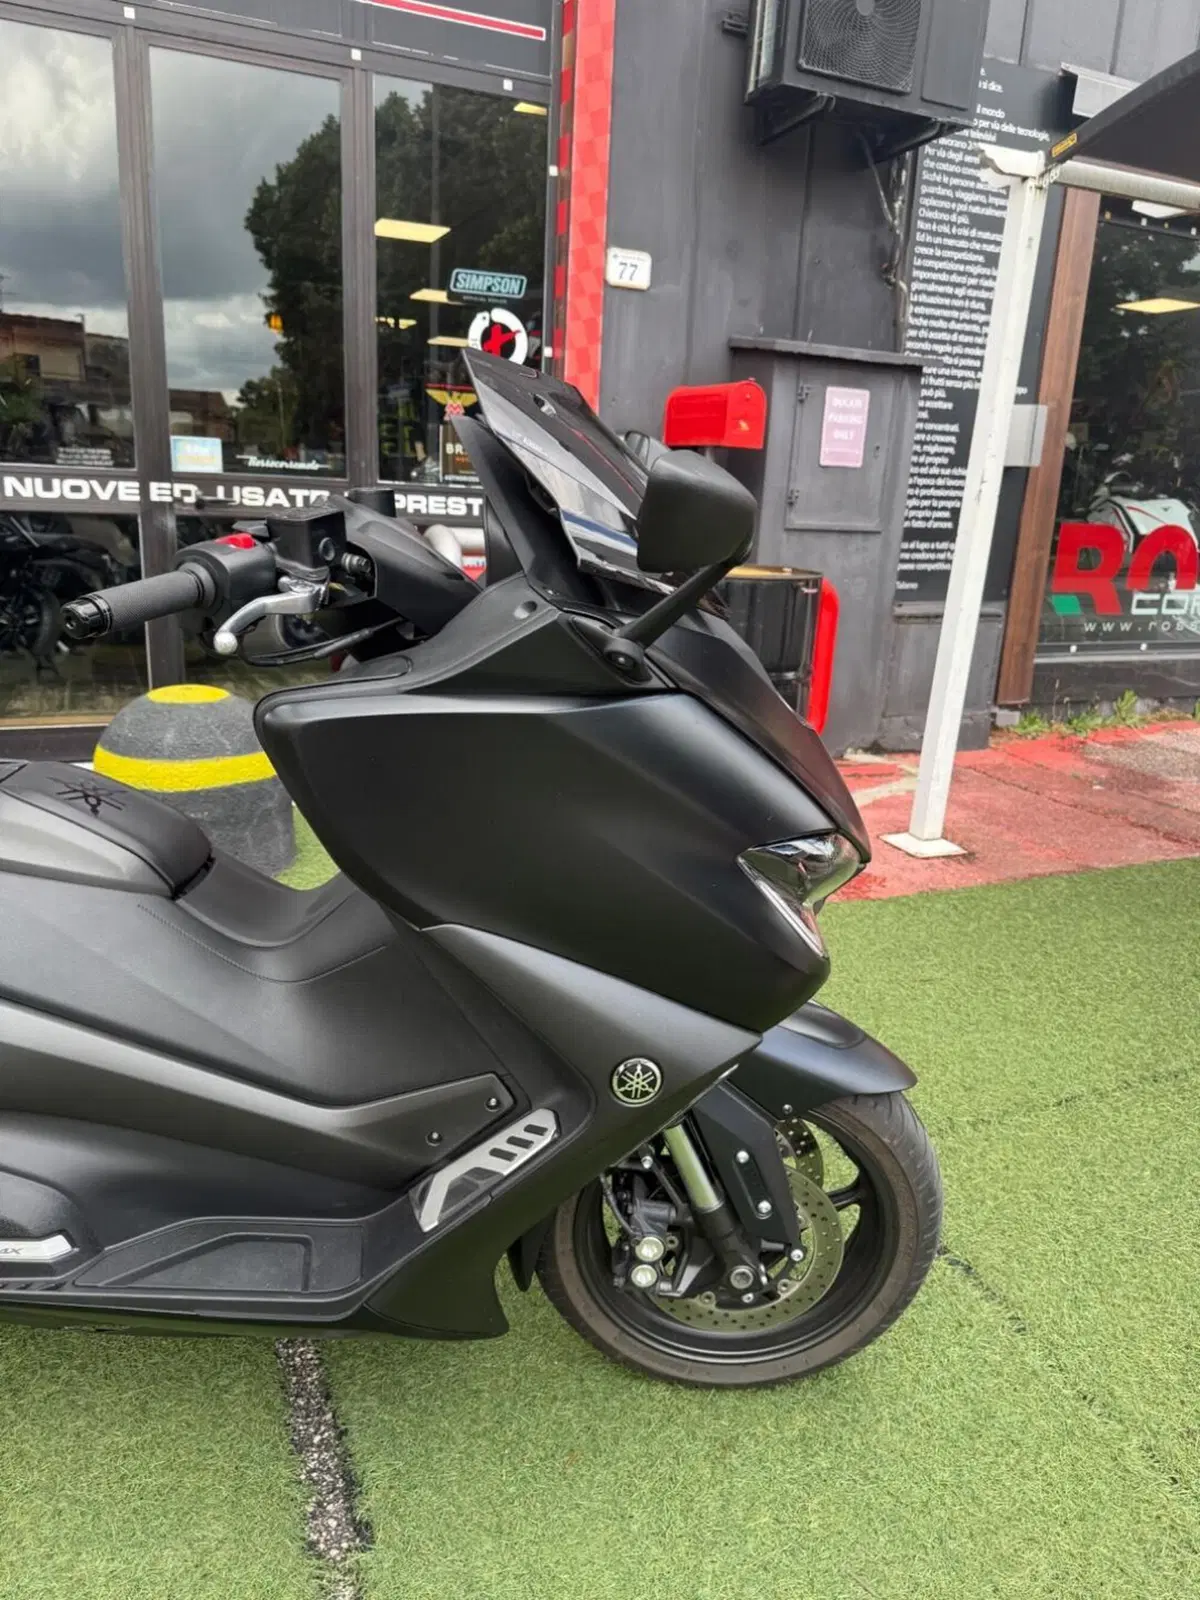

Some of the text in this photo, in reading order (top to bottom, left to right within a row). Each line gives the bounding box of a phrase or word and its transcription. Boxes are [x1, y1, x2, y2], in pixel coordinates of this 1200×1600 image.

[619, 261, 638, 281] 77
[456, 273, 520, 294] SIMPSON
[3, 475, 140, 502] NUOVE
